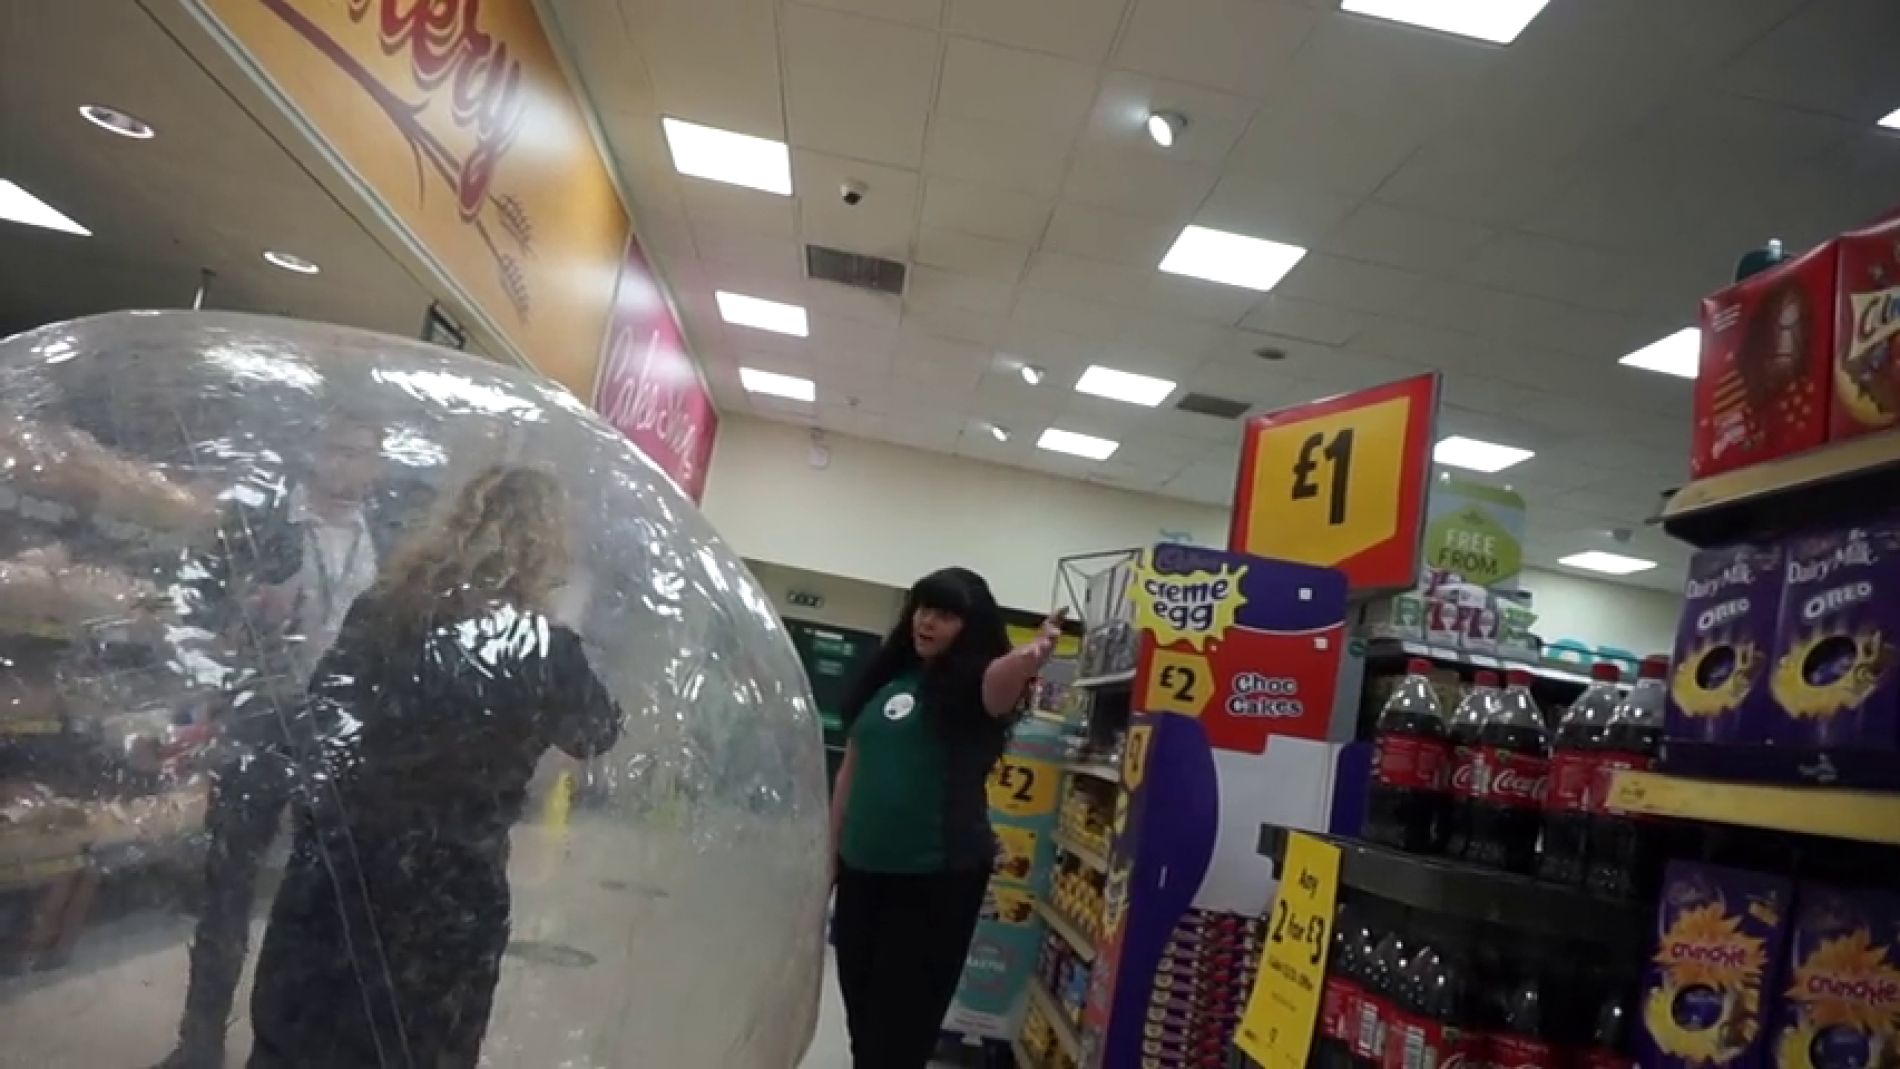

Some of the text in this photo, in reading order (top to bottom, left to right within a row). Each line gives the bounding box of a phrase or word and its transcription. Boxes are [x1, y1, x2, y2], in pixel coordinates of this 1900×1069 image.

[1291, 427, 1355, 526] £1
[1445, 529, 1497, 556] FREE
[1438, 547, 1498, 577] FROM
[1144, 577, 1230, 603] creme
[1804, 581, 1873, 620] OREO
[1152, 600, 1215, 631] egg
[1696, 598, 1750, 631] OREO
[1159, 664, 1197, 703] £2
[1233, 672, 1298, 695] Choc
[1227, 694, 1304, 718] Cakes
